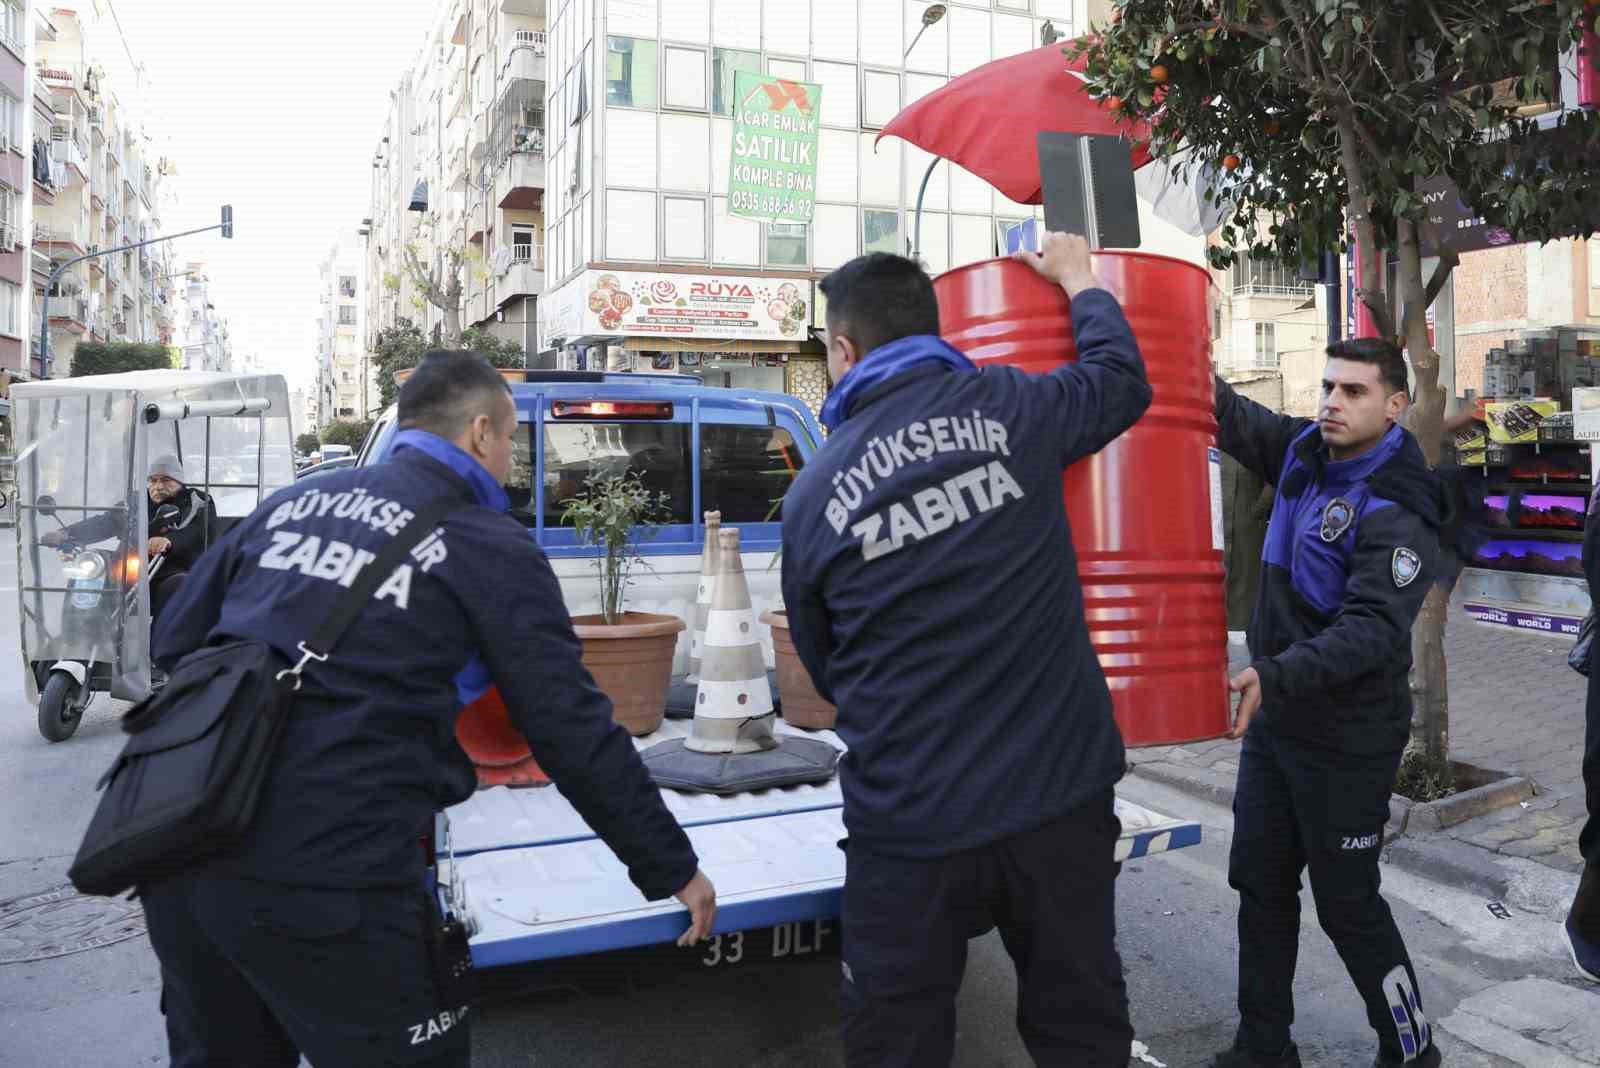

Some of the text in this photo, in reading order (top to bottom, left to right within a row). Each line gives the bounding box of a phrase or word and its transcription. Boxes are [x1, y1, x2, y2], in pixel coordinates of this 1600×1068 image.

[774, 114, 816, 134] EMLAK
[735, 132, 811, 165] SATILIK
[734, 165, 783, 187] KOMPLE
[690, 280, 754, 297] RÜYA
[824, 409, 1011, 537] BÜYÜKŞEHİR
[850, 460, 1025, 562] ZABITA
[265, 488, 448, 573] BÜYÜKŞEİR
[1517, 618, 1551, 629] WORLD
[1560, 623, 1580, 633] WO
[702, 929, 744, 967] 33
